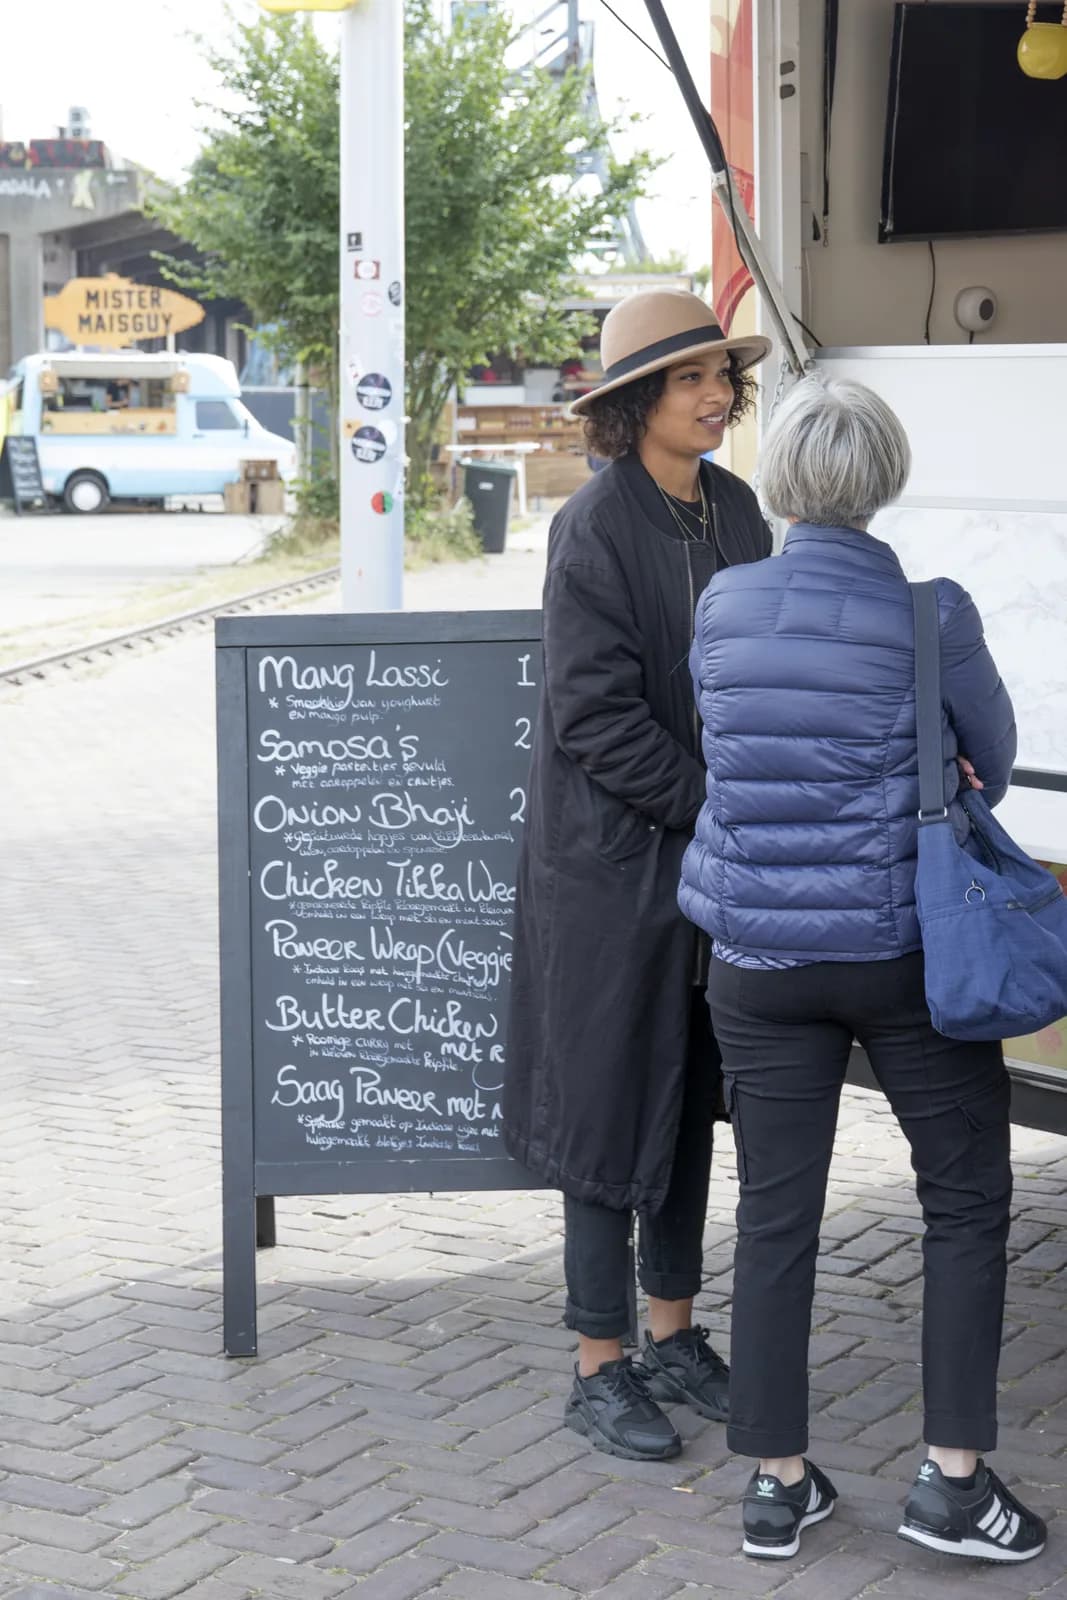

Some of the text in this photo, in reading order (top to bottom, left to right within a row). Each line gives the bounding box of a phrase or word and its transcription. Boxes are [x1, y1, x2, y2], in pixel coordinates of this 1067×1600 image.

[85, 288, 163, 309] MISTER
[78, 313, 173, 334] MAISGUY
[366, 650, 449, 688] Lassi
[351, 699, 376, 708] van
[308, 711, 347, 727] mango
[257, 717, 532, 762] Samosa's 2
[290, 762, 328, 779] Veggie
[402, 758, 447, 776] gevuld
[291, 779, 316, 789] met
[254, 787, 527, 848] Onion Bhaji 2
[260, 859, 383, 900] Chicken
[387, 859, 465, 901] Tikka
[265, 919, 365, 960] Paneer
[370, 926, 435, 984] Wrap
[338, 976, 348, 986] in
[369, 966, 389, 976] met
[265, 993, 497, 1042] Butter Chicken
[394, 1038, 414, 1051] met
[441, 1042, 483, 1062] met
[271, 1064, 344, 1122] Saag
[350, 1066, 442, 1116] Paneer
[447, 1089, 486, 1120] met
[350, 1114, 396, 1133] gemaakt
[398, 1121, 413, 1133] op
[481, 1124, 500, 1137] met
